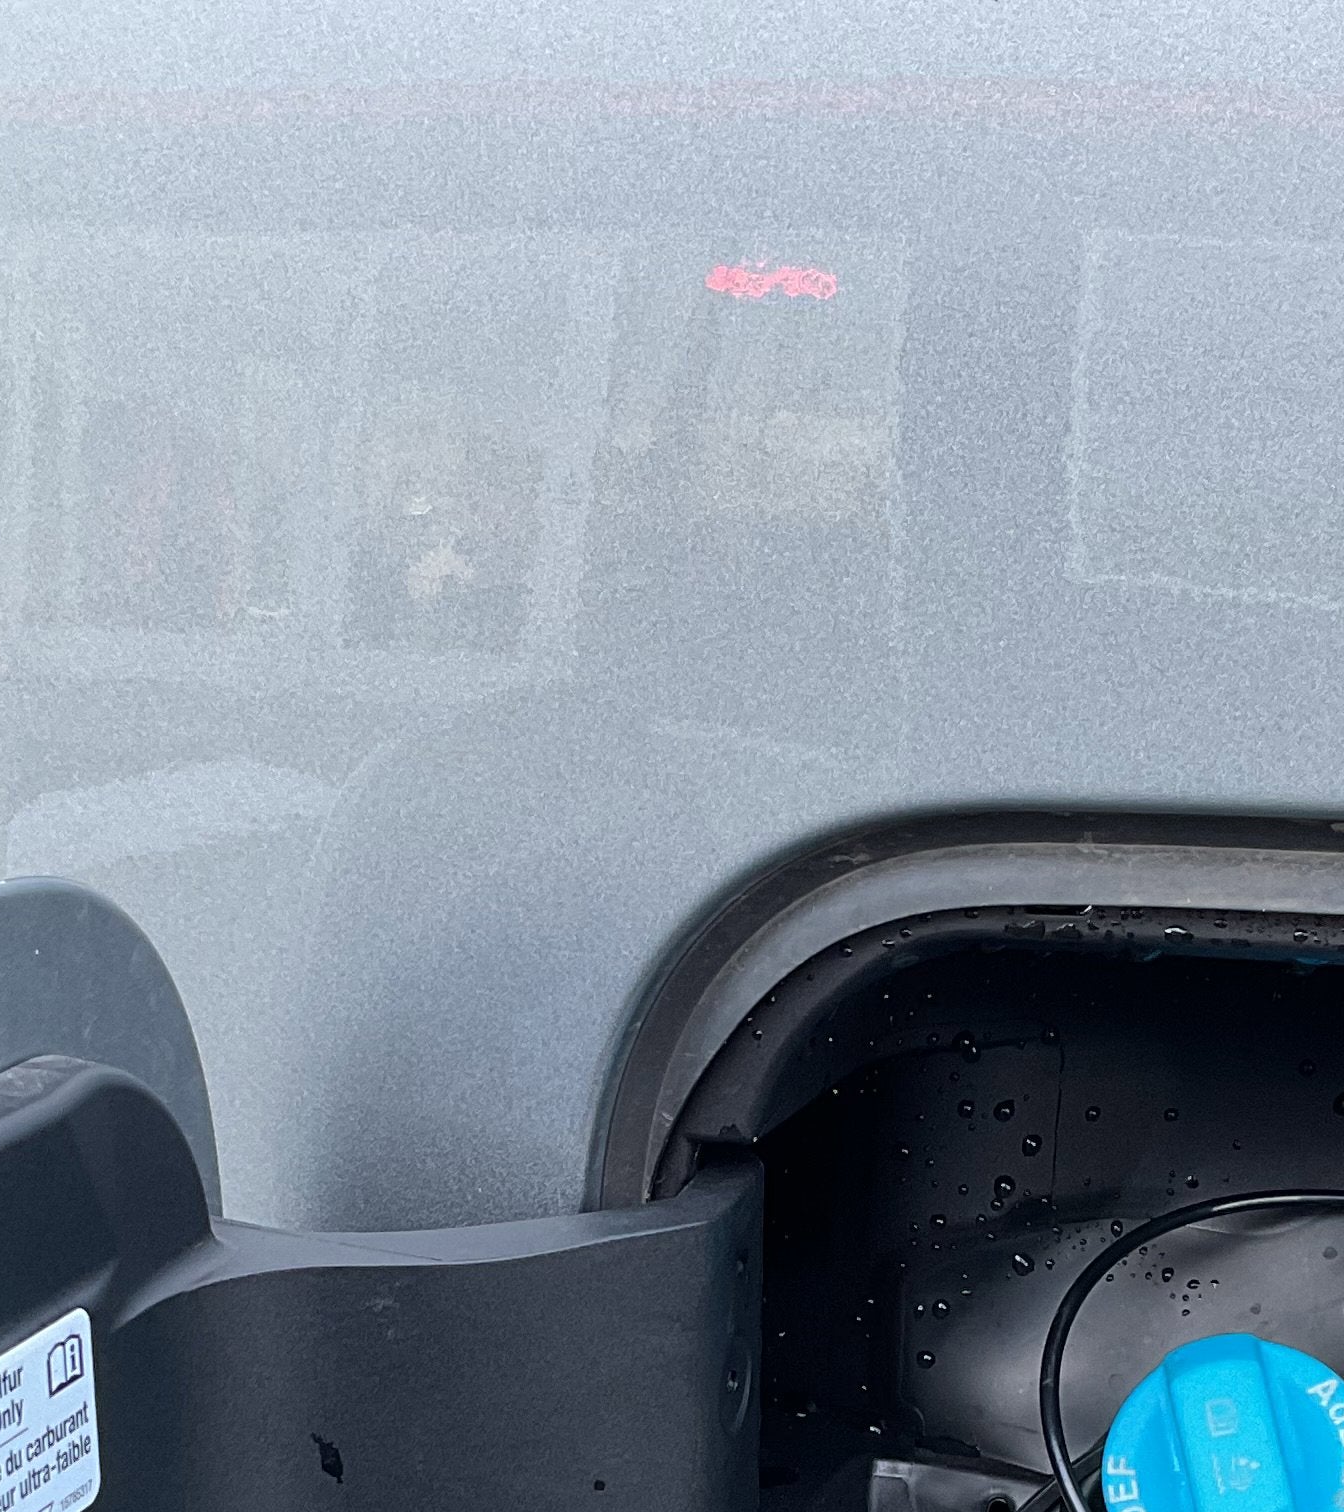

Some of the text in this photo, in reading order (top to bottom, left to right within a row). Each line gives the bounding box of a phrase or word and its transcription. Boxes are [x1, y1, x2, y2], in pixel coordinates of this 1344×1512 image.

[6, 1445, 24, 1478] du
[27, 1402, 89, 1460] carburant
[20, 1433, 92, 1499] ultra-faible
